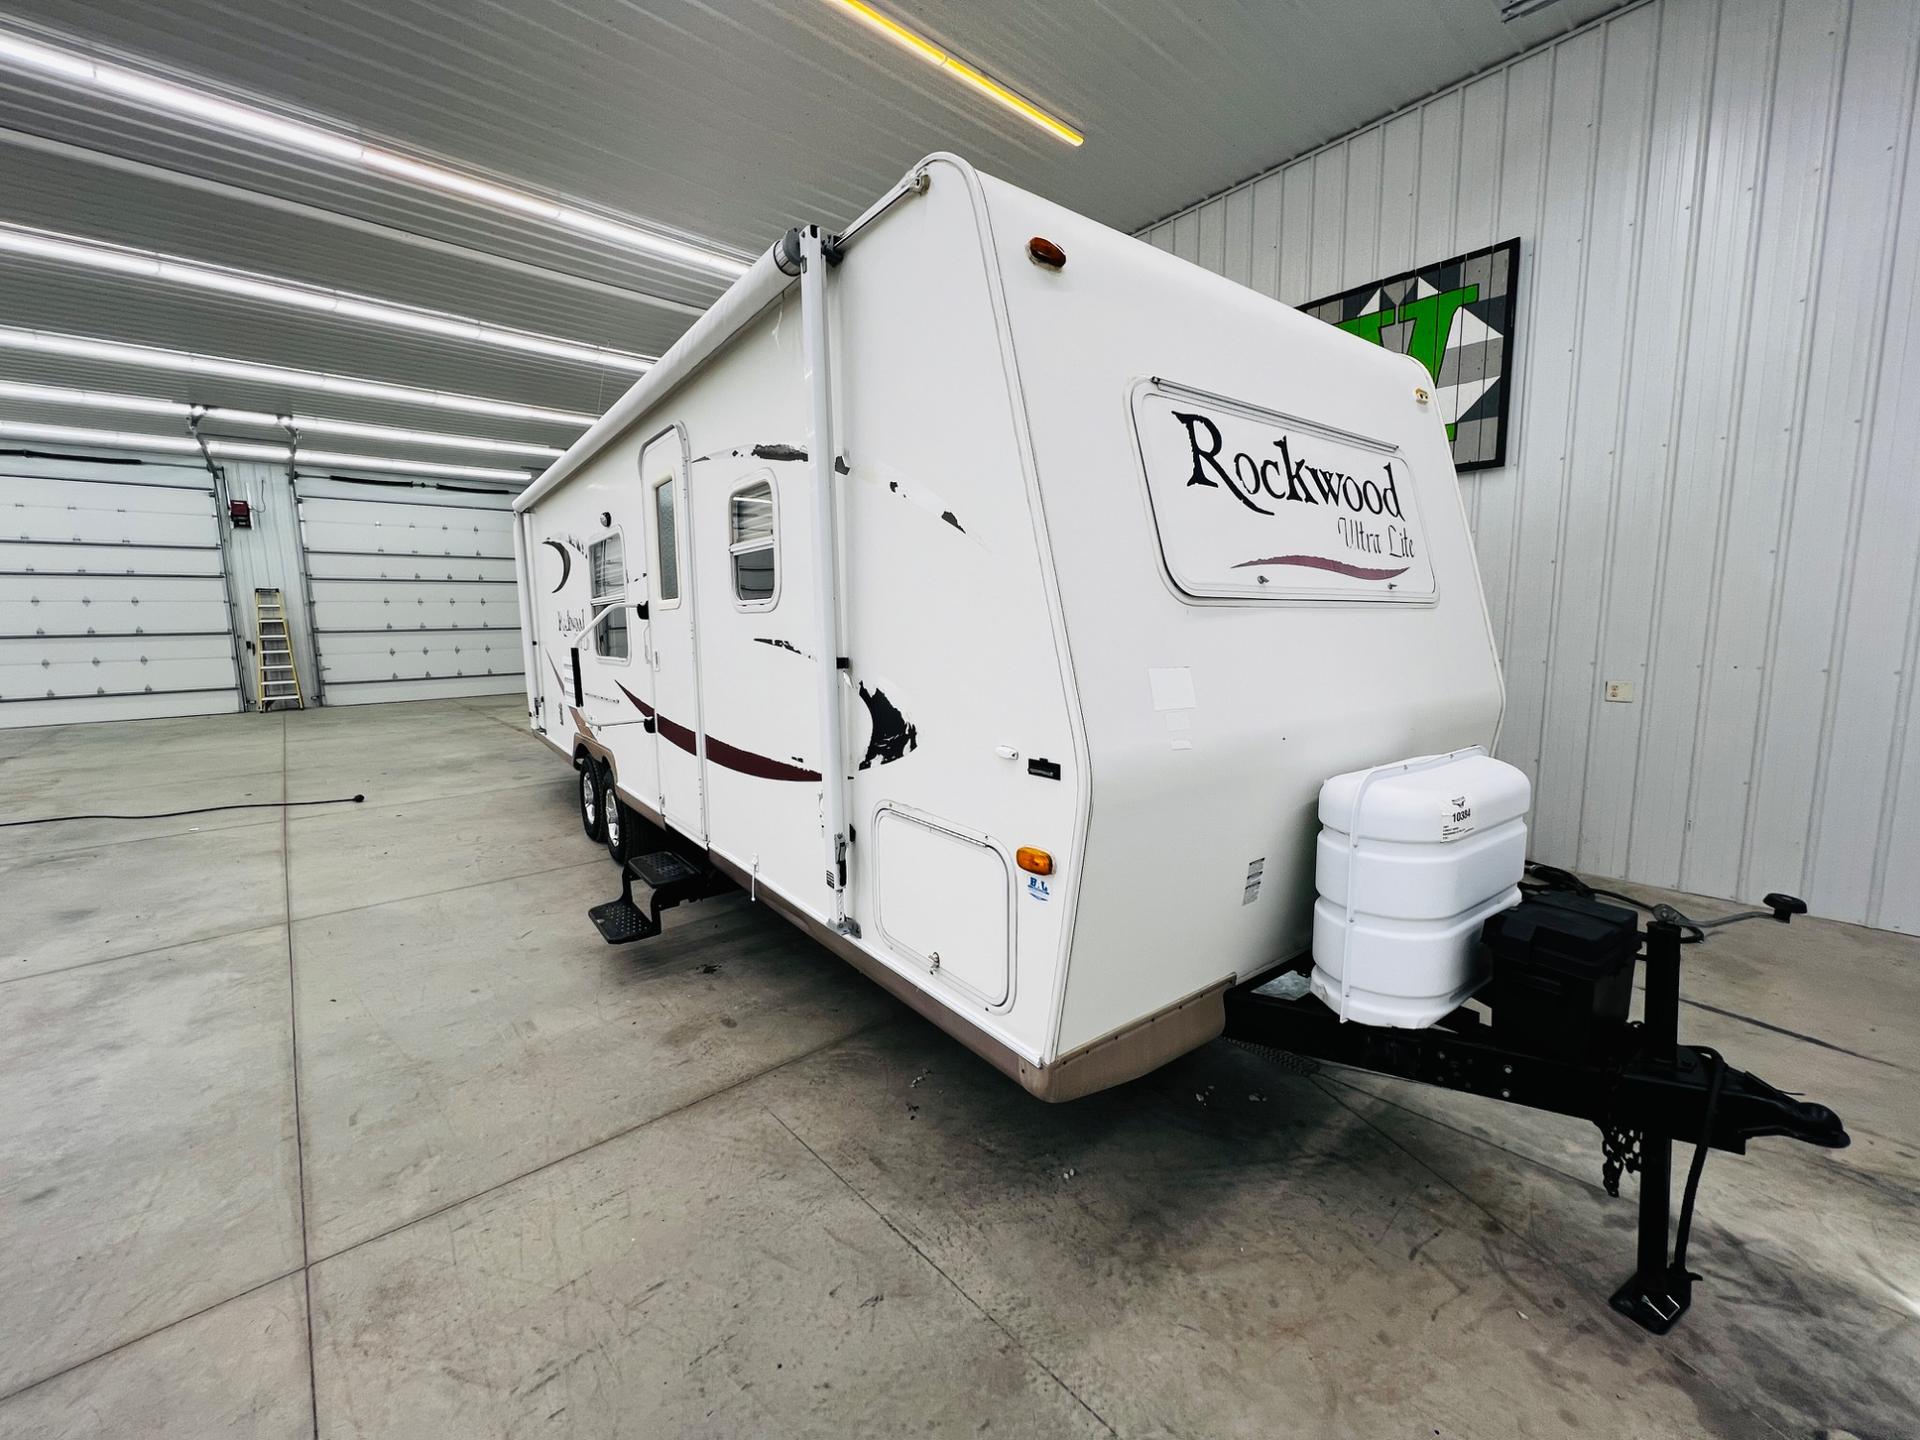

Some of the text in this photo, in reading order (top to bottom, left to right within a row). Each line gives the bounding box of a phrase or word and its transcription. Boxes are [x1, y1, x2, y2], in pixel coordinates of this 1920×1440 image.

[1171, 410, 1405, 521] Rockwood
[1337, 516, 1415, 558] Ultra Lite
